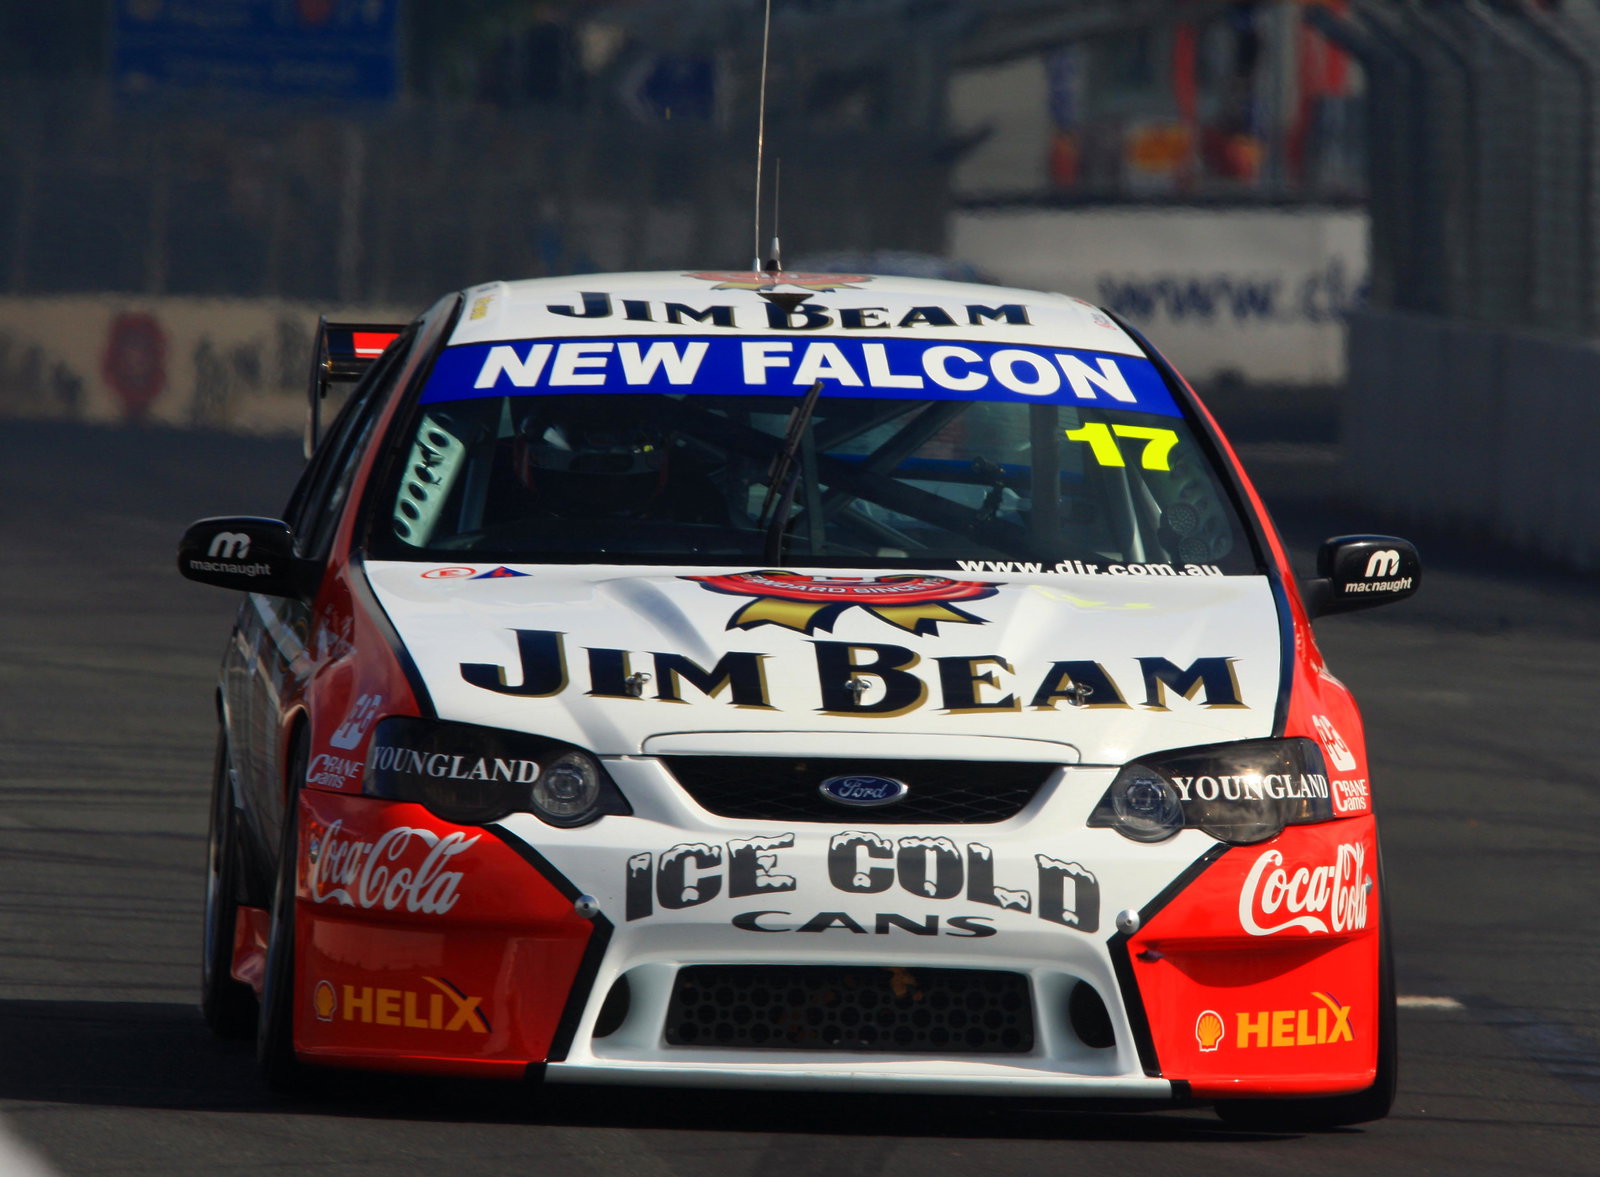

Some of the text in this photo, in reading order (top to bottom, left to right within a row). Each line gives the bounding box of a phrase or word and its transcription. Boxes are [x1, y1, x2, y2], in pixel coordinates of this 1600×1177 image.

[545, 291, 741, 328] JIM
[762, 301, 1034, 330] BEAM
[473, 341, 1138, 403] NEW FALCON
[1065, 421, 1179, 472] 17
[189, 560, 272, 577] macnaught
[1345, 577, 1412, 592] macnaught
[459, 628, 784, 712] JIM
[803, 638, 1251, 718] BEAM
[306, 754, 364, 780] CRANE
[370, 745, 541, 784] YOUNGLAND
[838, 779, 889, 798] Ford
[1172, 773, 1329, 801] YOUNGLAND
[1332, 779, 1368, 804] CRANE
[311, 819, 482, 915] Coca-Cola
[626, 830, 1100, 934] ICE COLD
[1238, 841, 1368, 937] Coca-Cola
[731, 910, 998, 938] CANS
[342, 975, 491, 1034] HELIX
[1236, 991, 1355, 1049] HELIX
